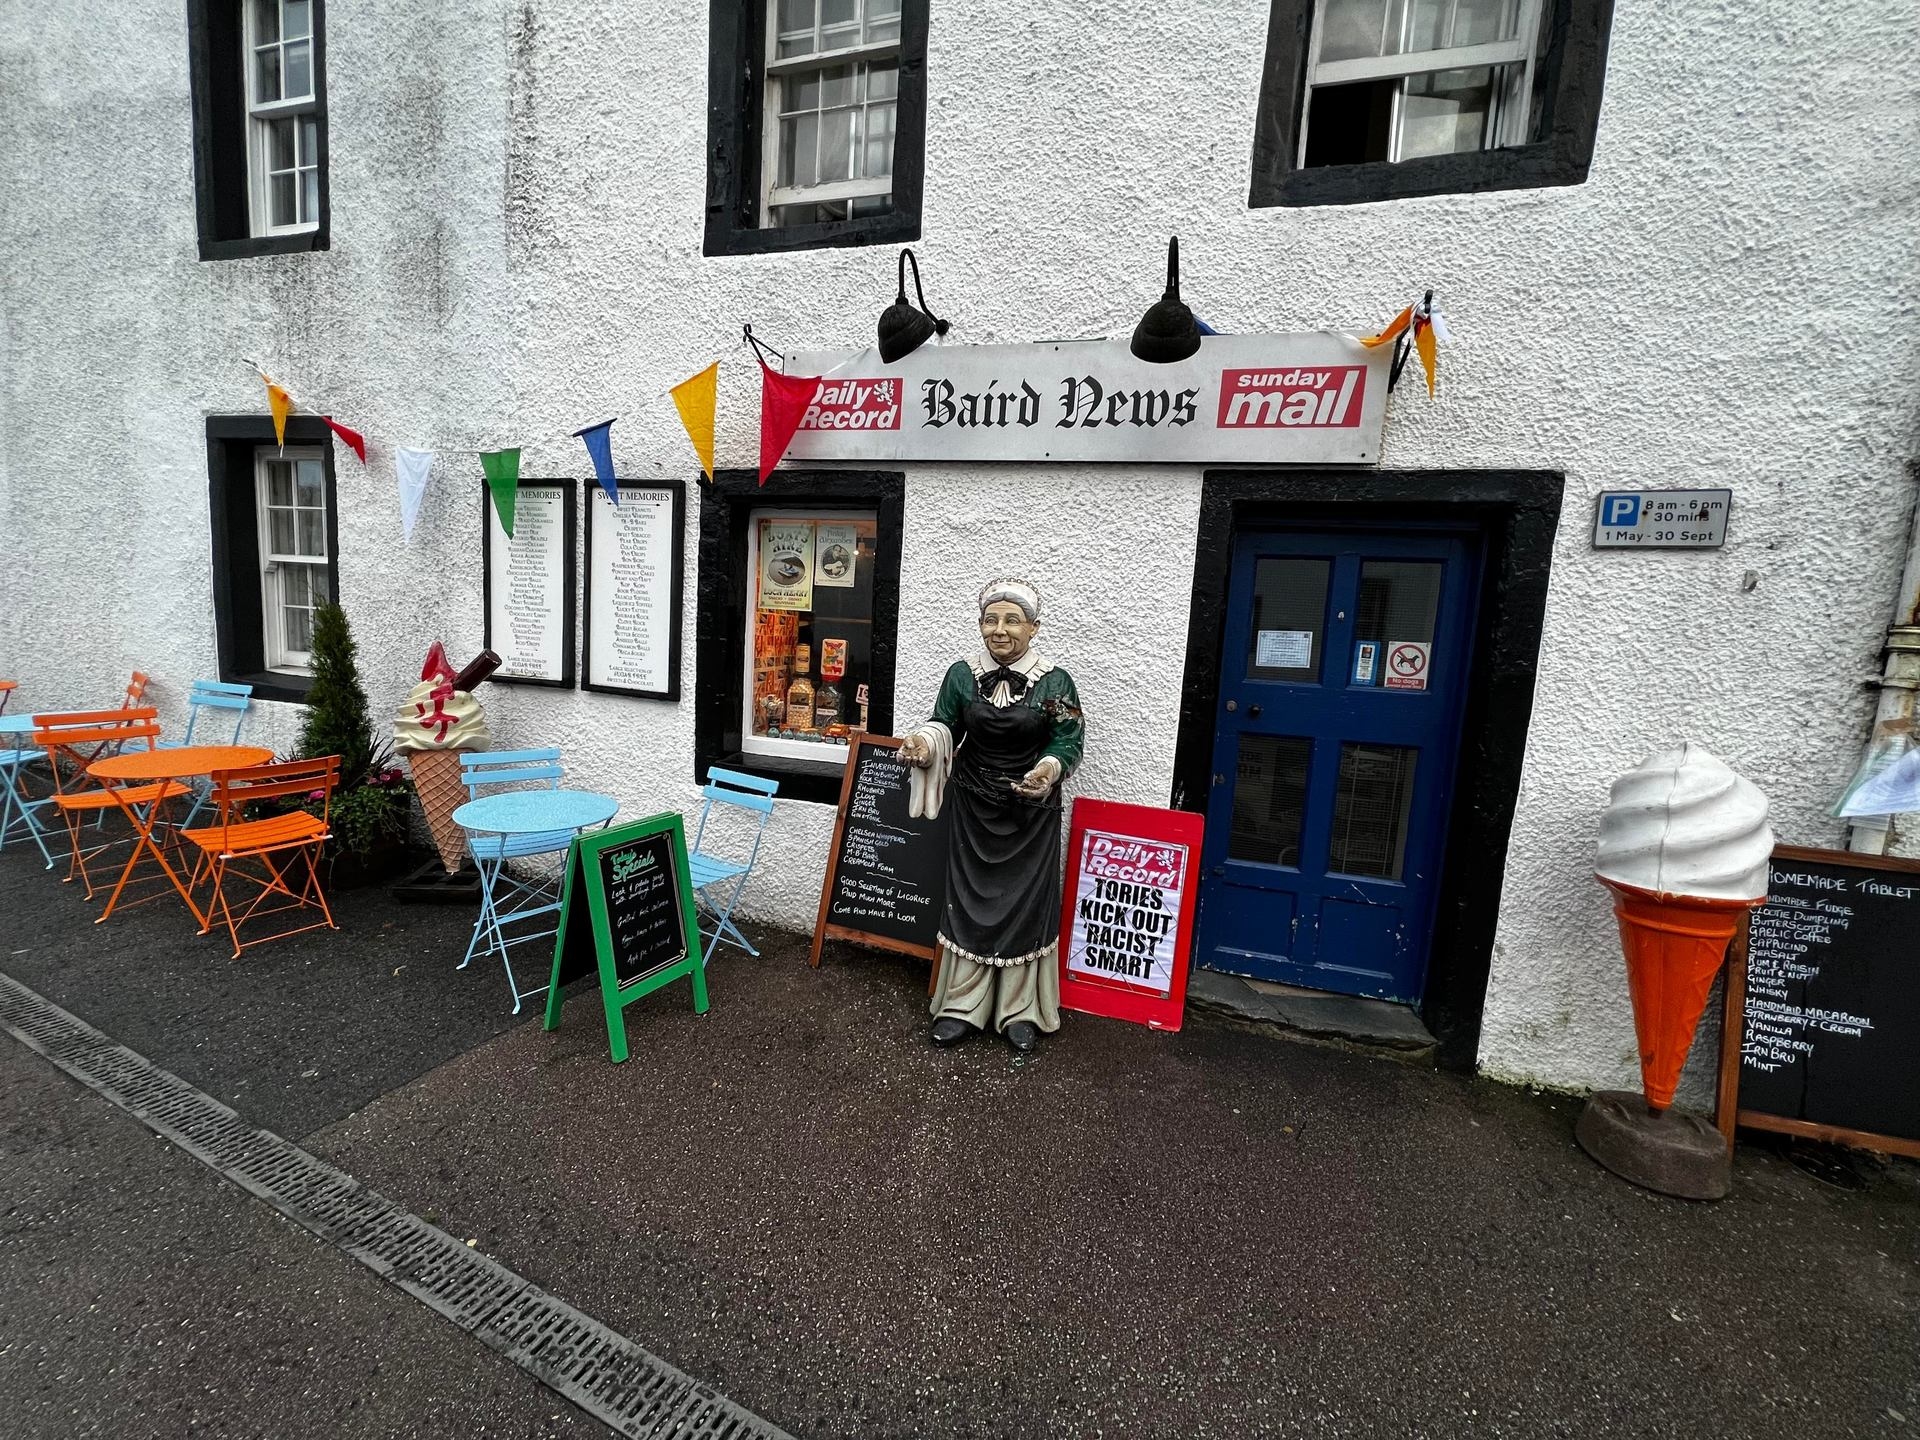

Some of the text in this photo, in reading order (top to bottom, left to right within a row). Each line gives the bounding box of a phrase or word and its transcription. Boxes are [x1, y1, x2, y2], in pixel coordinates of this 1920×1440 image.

[1237, 370, 1332, 389] sunday
[920, 375, 1200, 428] Baird News
[1224, 370, 1360, 425] mail
[798, 405, 898, 429] Record
[521, 491, 561, 499] MEMORIES
[625, 492, 670, 501] MEMORIES
[1611, 499, 1634, 523] P
[1645, 500, 1654, 510] 8
[1657, 502, 1677, 510] am
[1689, 500, 1698, 510] 6
[1700, 501, 1723, 511] pm
[1654, 512, 1673, 522] 30
[1605, 531, 1610, 540] 1
[1616, 531, 1644, 542] May
[1655, 531, 1675, 541] 30
[1680, 531, 1714, 542] Sept
[873, 748, 889, 757] NOW
[861, 759, 906, 775] INVERARAY
[848, 834, 874, 845] SPANISH
[849, 826, 875, 837] CHELSEA
[1091, 838, 1155, 868] Daily
[612, 850, 655, 882] Specials
[877, 863, 894, 874] FOAM
[1086, 856, 1177, 888] Record
[840, 876, 857, 887] GOOD
[897, 889, 931, 905] LICORICE
[841, 887, 857, 899] AND
[876, 897, 896, 909] MORE
[1094, 877, 1164, 911] TORIES
[1855, 879, 1920, 899] TABLET
[833, 901, 850, 914] COME
[853, 907, 866, 915] AND
[868, 909, 885, 918] HAVE
[897, 913, 916, 923] LOOK
[1080, 898, 1172, 935] KICK OUT
[1816, 899, 1854, 916] FUDGE
[1794, 912, 1849, 929] DUMPLING
[1749, 926, 1791, 939] GAELIC
[1749, 937, 1808, 952] CAPPUCINO
[1749, 947, 1800, 960] SEASALT
[1084, 946, 1155, 980] SMART
[1748, 955, 1770, 967] RUM
[1783, 960, 1819, 974] RAISIN
[1748, 964, 1778, 976] FRUIT
[1788, 972, 1813, 980] NUT
[1747, 974, 1785, 987] GINGER
[1749, 984, 1788, 1001] WHISKY
[1746, 997, 1870, 1026] HANDMAID MACAROON
[1742, 1009, 1808, 1030] STRAWBERRY
[1820, 1020, 1861, 1037] CREAM
[1747, 1018, 1793, 1036] VANILLA
[1740, 1042, 1796, 1063] IRN BRU
[1746, 1029, 1814, 1058] RASPBERRY
[1744, 1055, 1782, 1073] MINT
